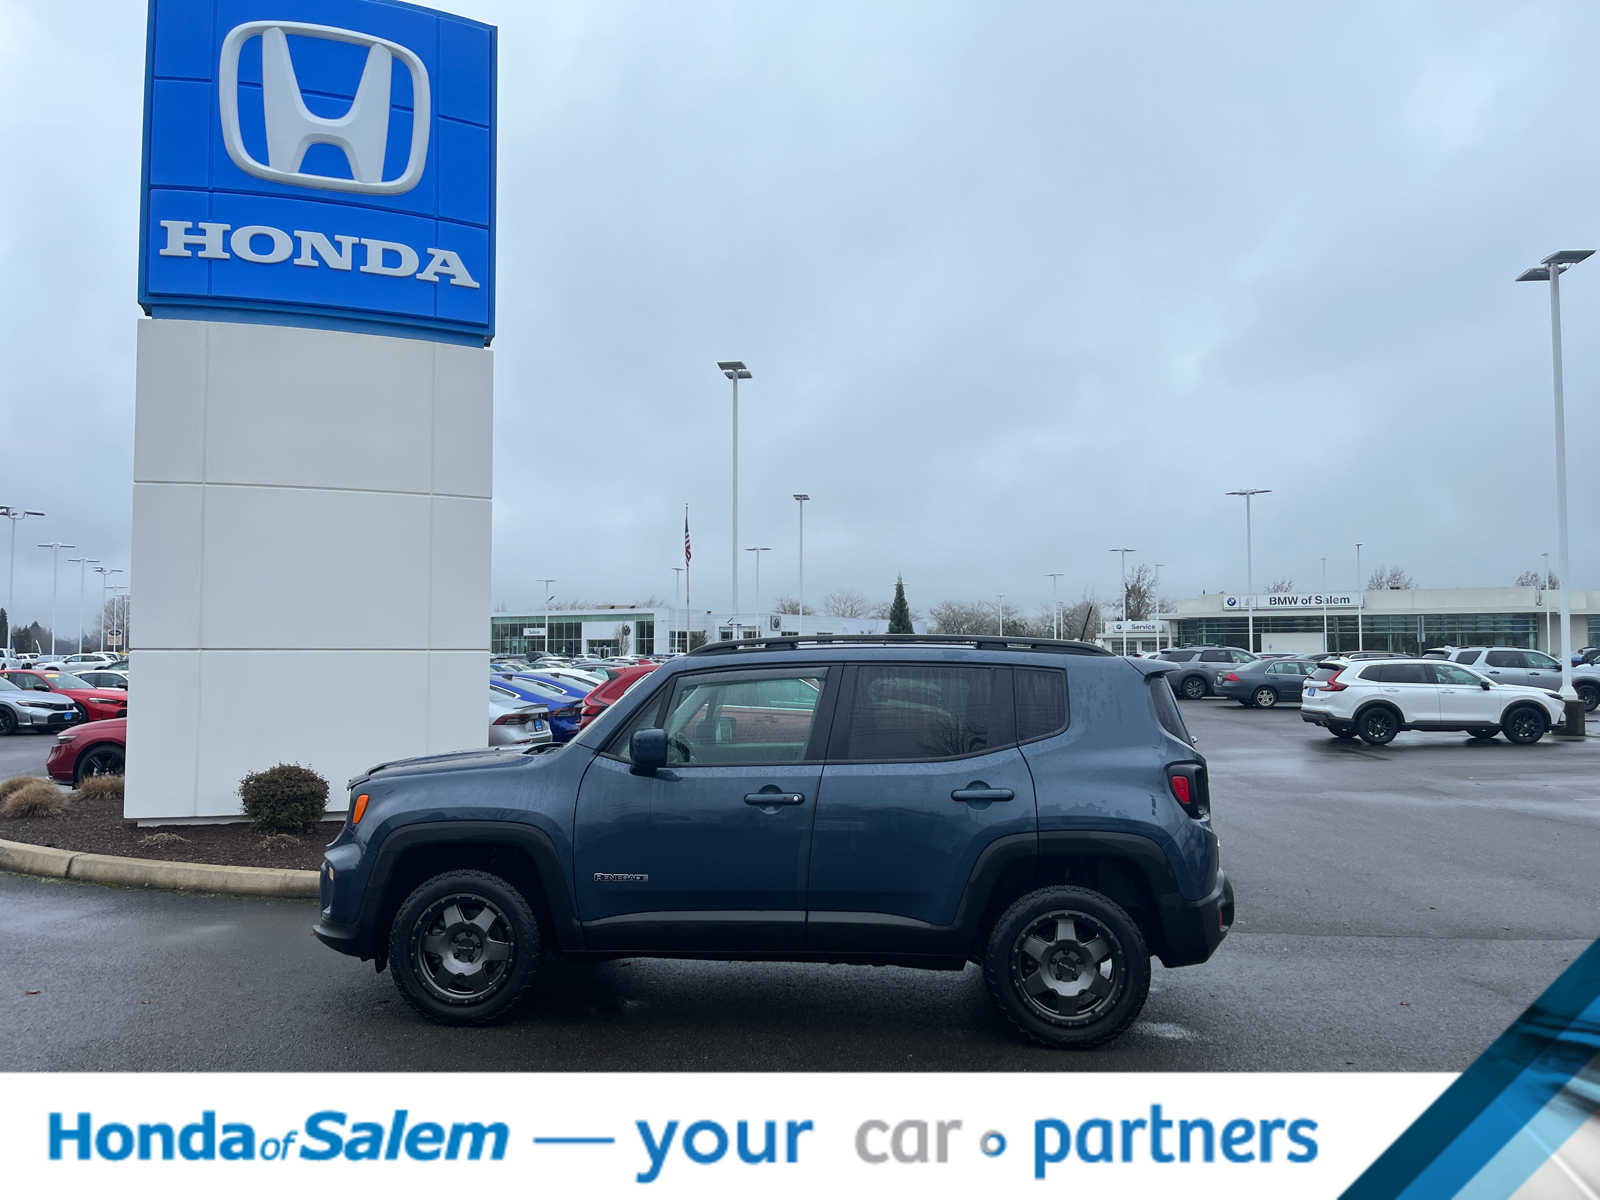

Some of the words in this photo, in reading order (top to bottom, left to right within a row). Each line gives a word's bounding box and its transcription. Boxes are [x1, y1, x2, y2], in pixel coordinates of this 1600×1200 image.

[160, 220, 480, 288] HONDA
[1269, 596, 1299, 606] BMW
[1301, 595, 1312, 605] of
[1314, 594, 1350, 605] Salem
[593, 872, 649, 882] RENEGAD
